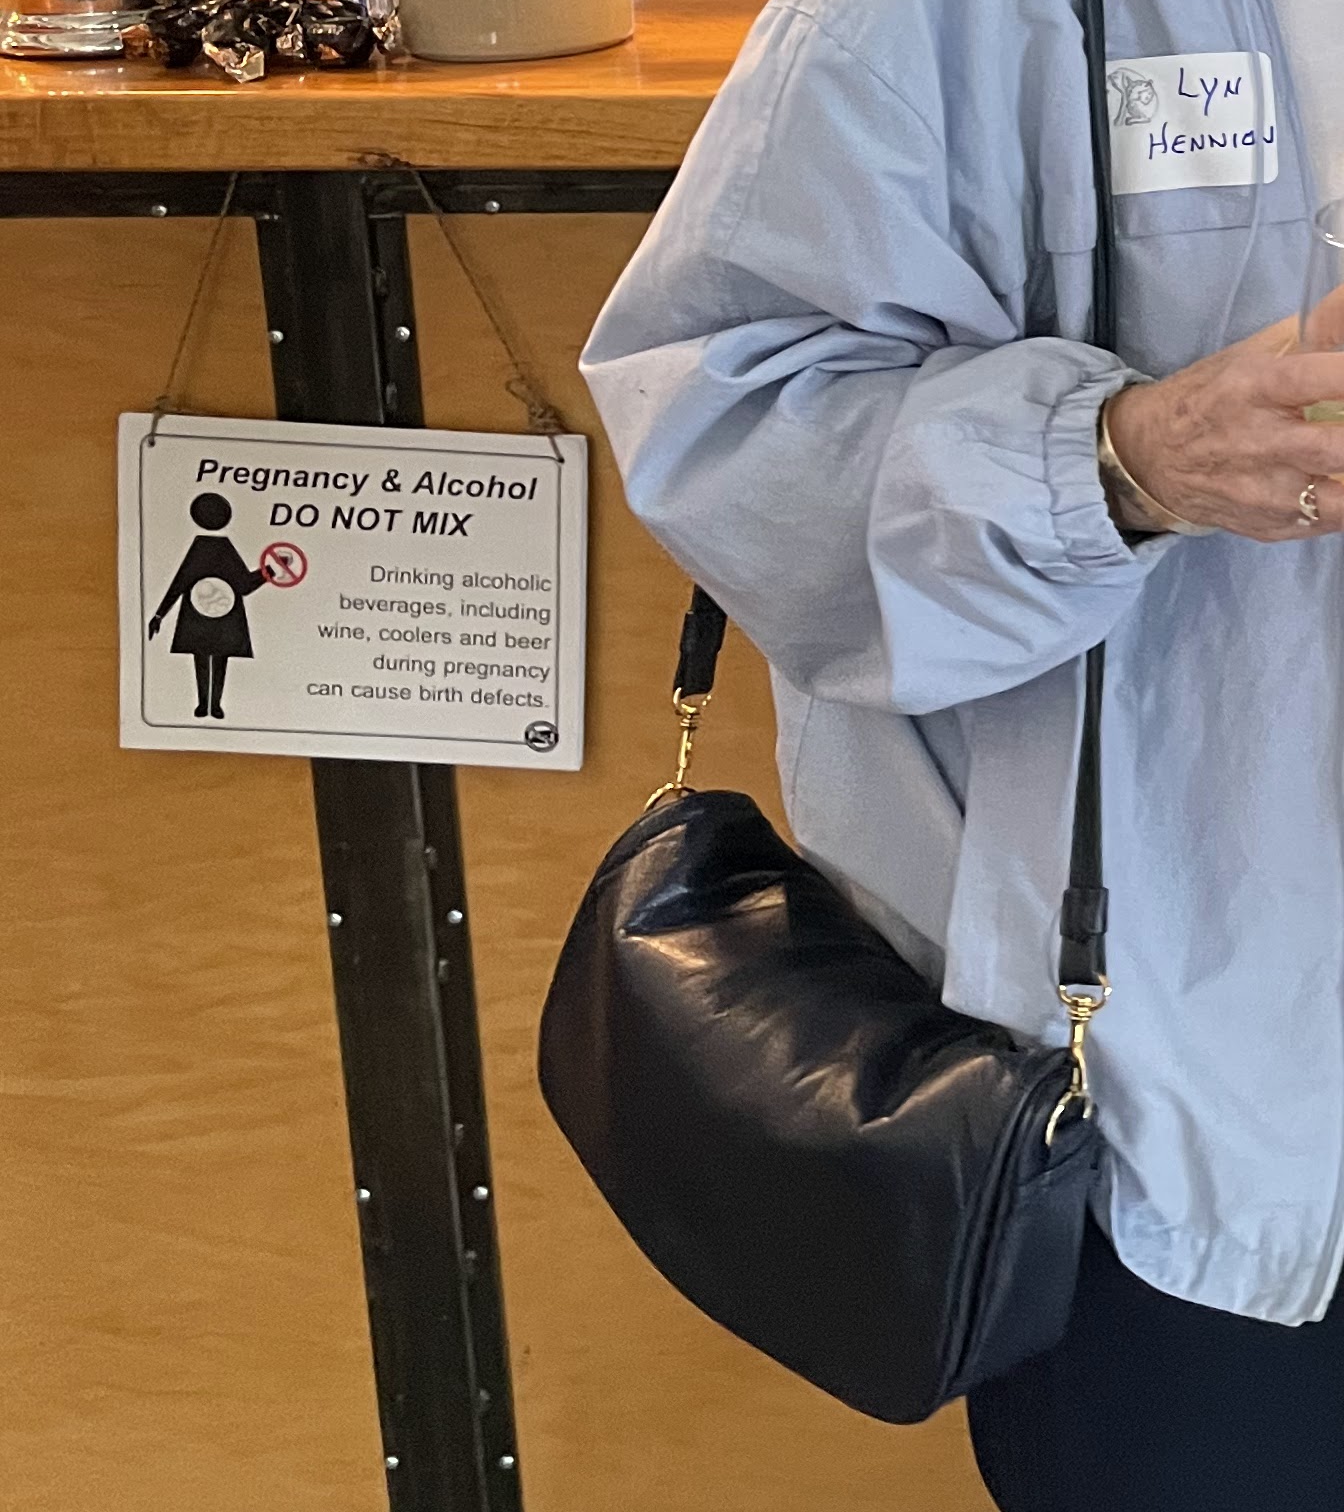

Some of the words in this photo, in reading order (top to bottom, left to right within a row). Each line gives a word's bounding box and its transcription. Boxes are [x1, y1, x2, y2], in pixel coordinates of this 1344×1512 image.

[196, 459, 369, 496] Pregnancy
[381, 469, 400, 492] &
[411, 471, 537, 499] Alcohol
[270, 503, 319, 527] DO
[331, 506, 402, 531] NOT
[412, 511, 472, 536] MIX
[370, 565, 453, 590] Drinking
[462, 571, 552, 592] alcoholic
[340, 593, 452, 618] beverages,
[461, 599, 551, 625] including
[317, 621, 370, 642] wine,
[379, 626, 452, 644] coolers
[460, 631, 496, 647] and
[505, 632, 551, 650] beer
[373, 653, 435, 677] during
[444, 659, 550, 682] pregnancy
[307, 683, 342, 696] can
[351, 685, 411, 700] cause
[419, 684, 462, 702] birth
[471, 688, 550, 708] defects.
